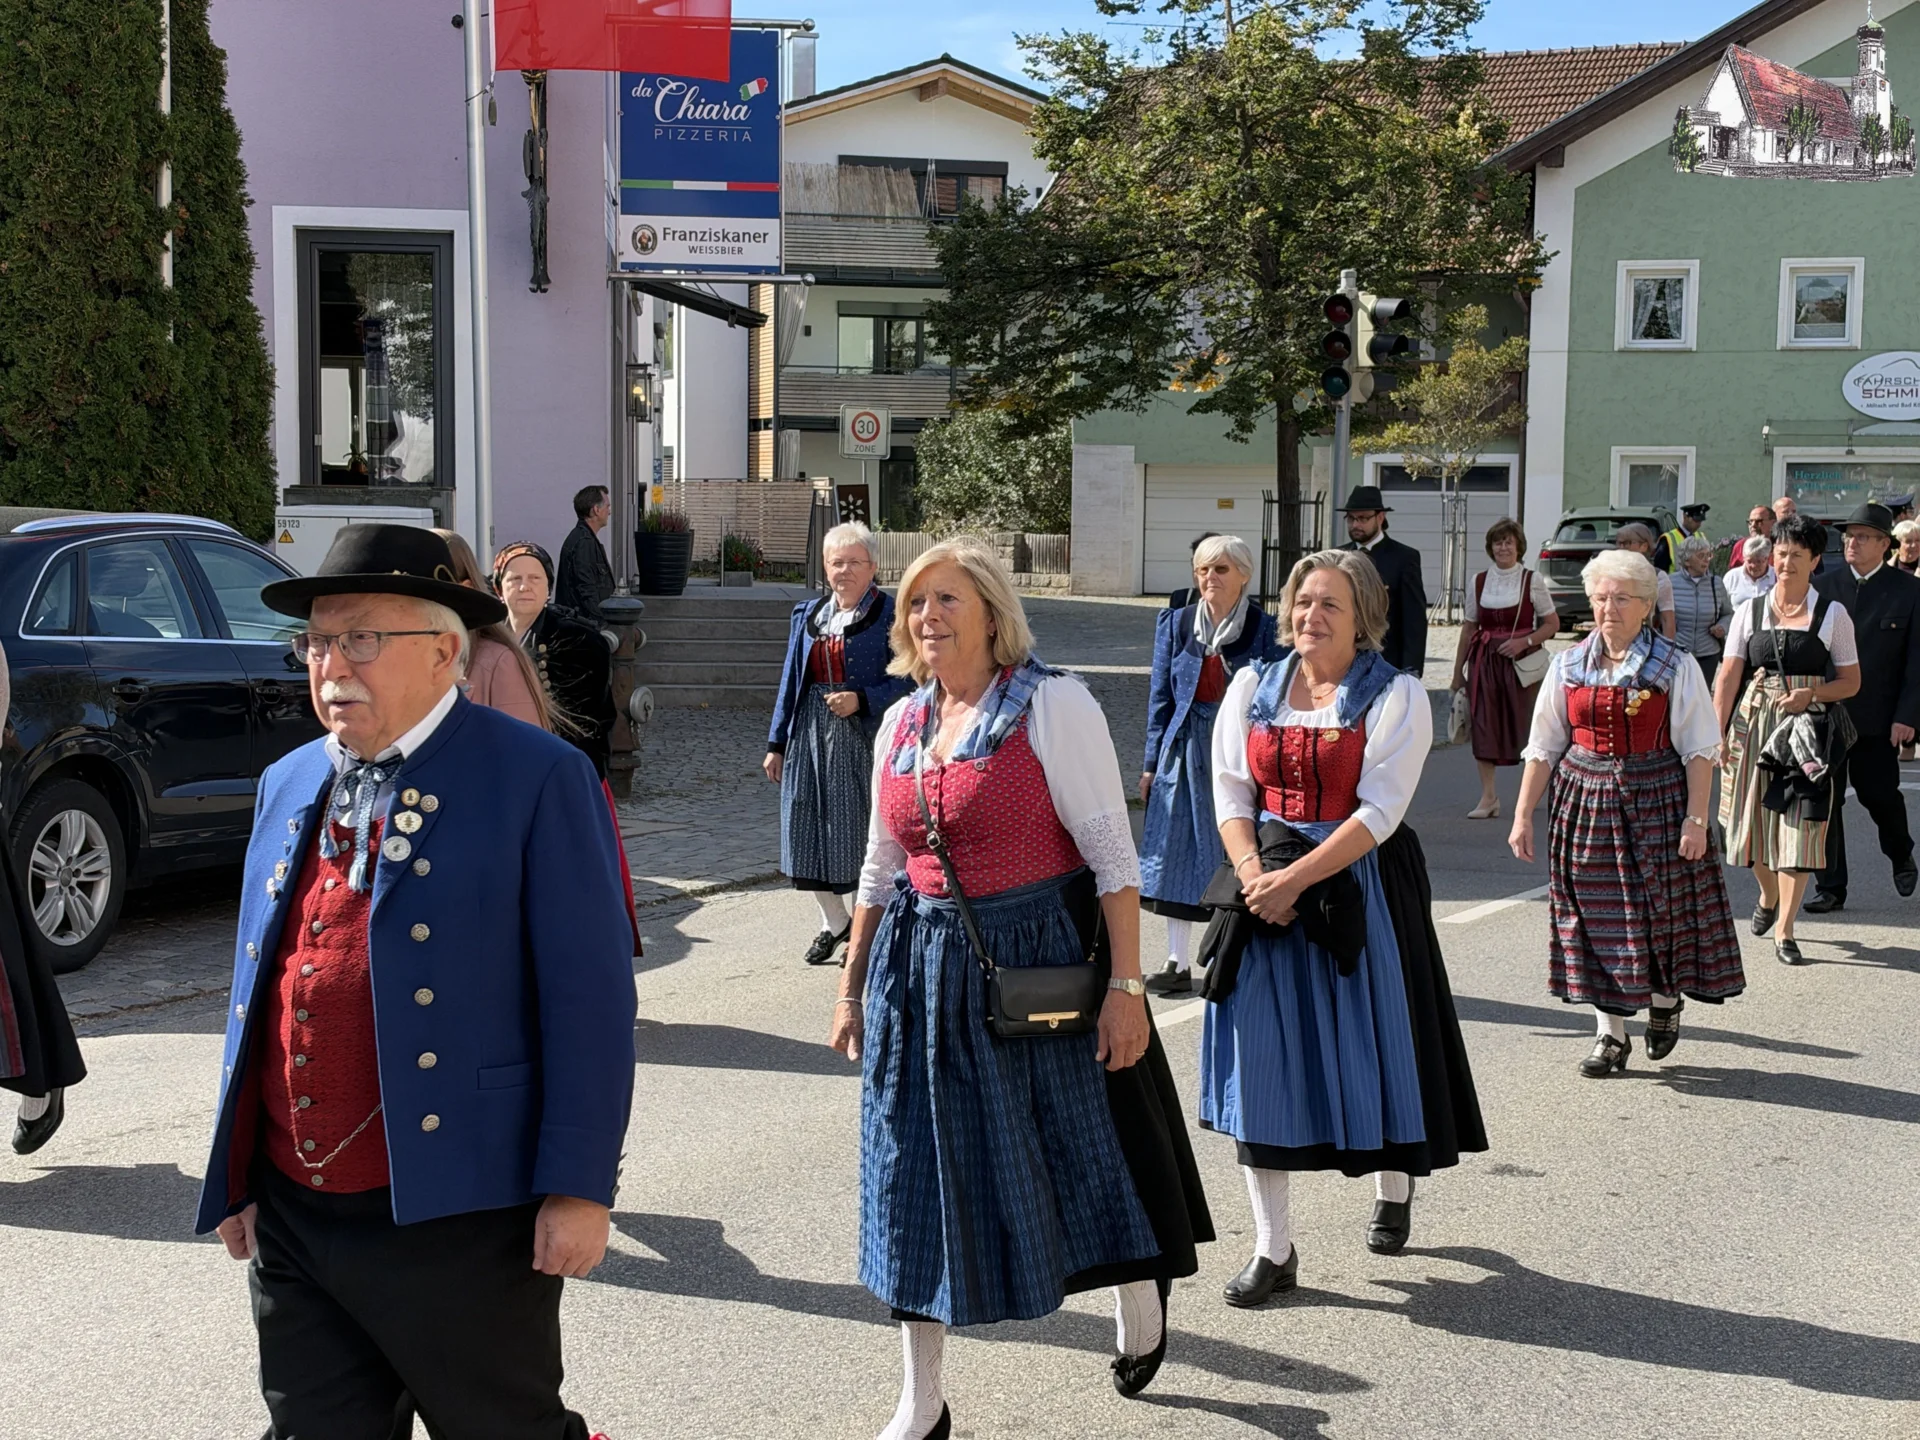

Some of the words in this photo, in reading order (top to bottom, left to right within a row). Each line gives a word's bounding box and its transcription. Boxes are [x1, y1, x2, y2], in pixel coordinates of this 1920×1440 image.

[631, 78, 653, 98] da
[654, 77, 752, 123] Chiara
[654, 128, 752, 142] PIZZERIA
[662, 227, 769, 244] Franziskaner
[688, 245, 744, 256] WEISSBIER
[857, 420, 875, 434] 30
[854, 444, 876, 453] ZONE
[277, 519, 300, 528] 59123
